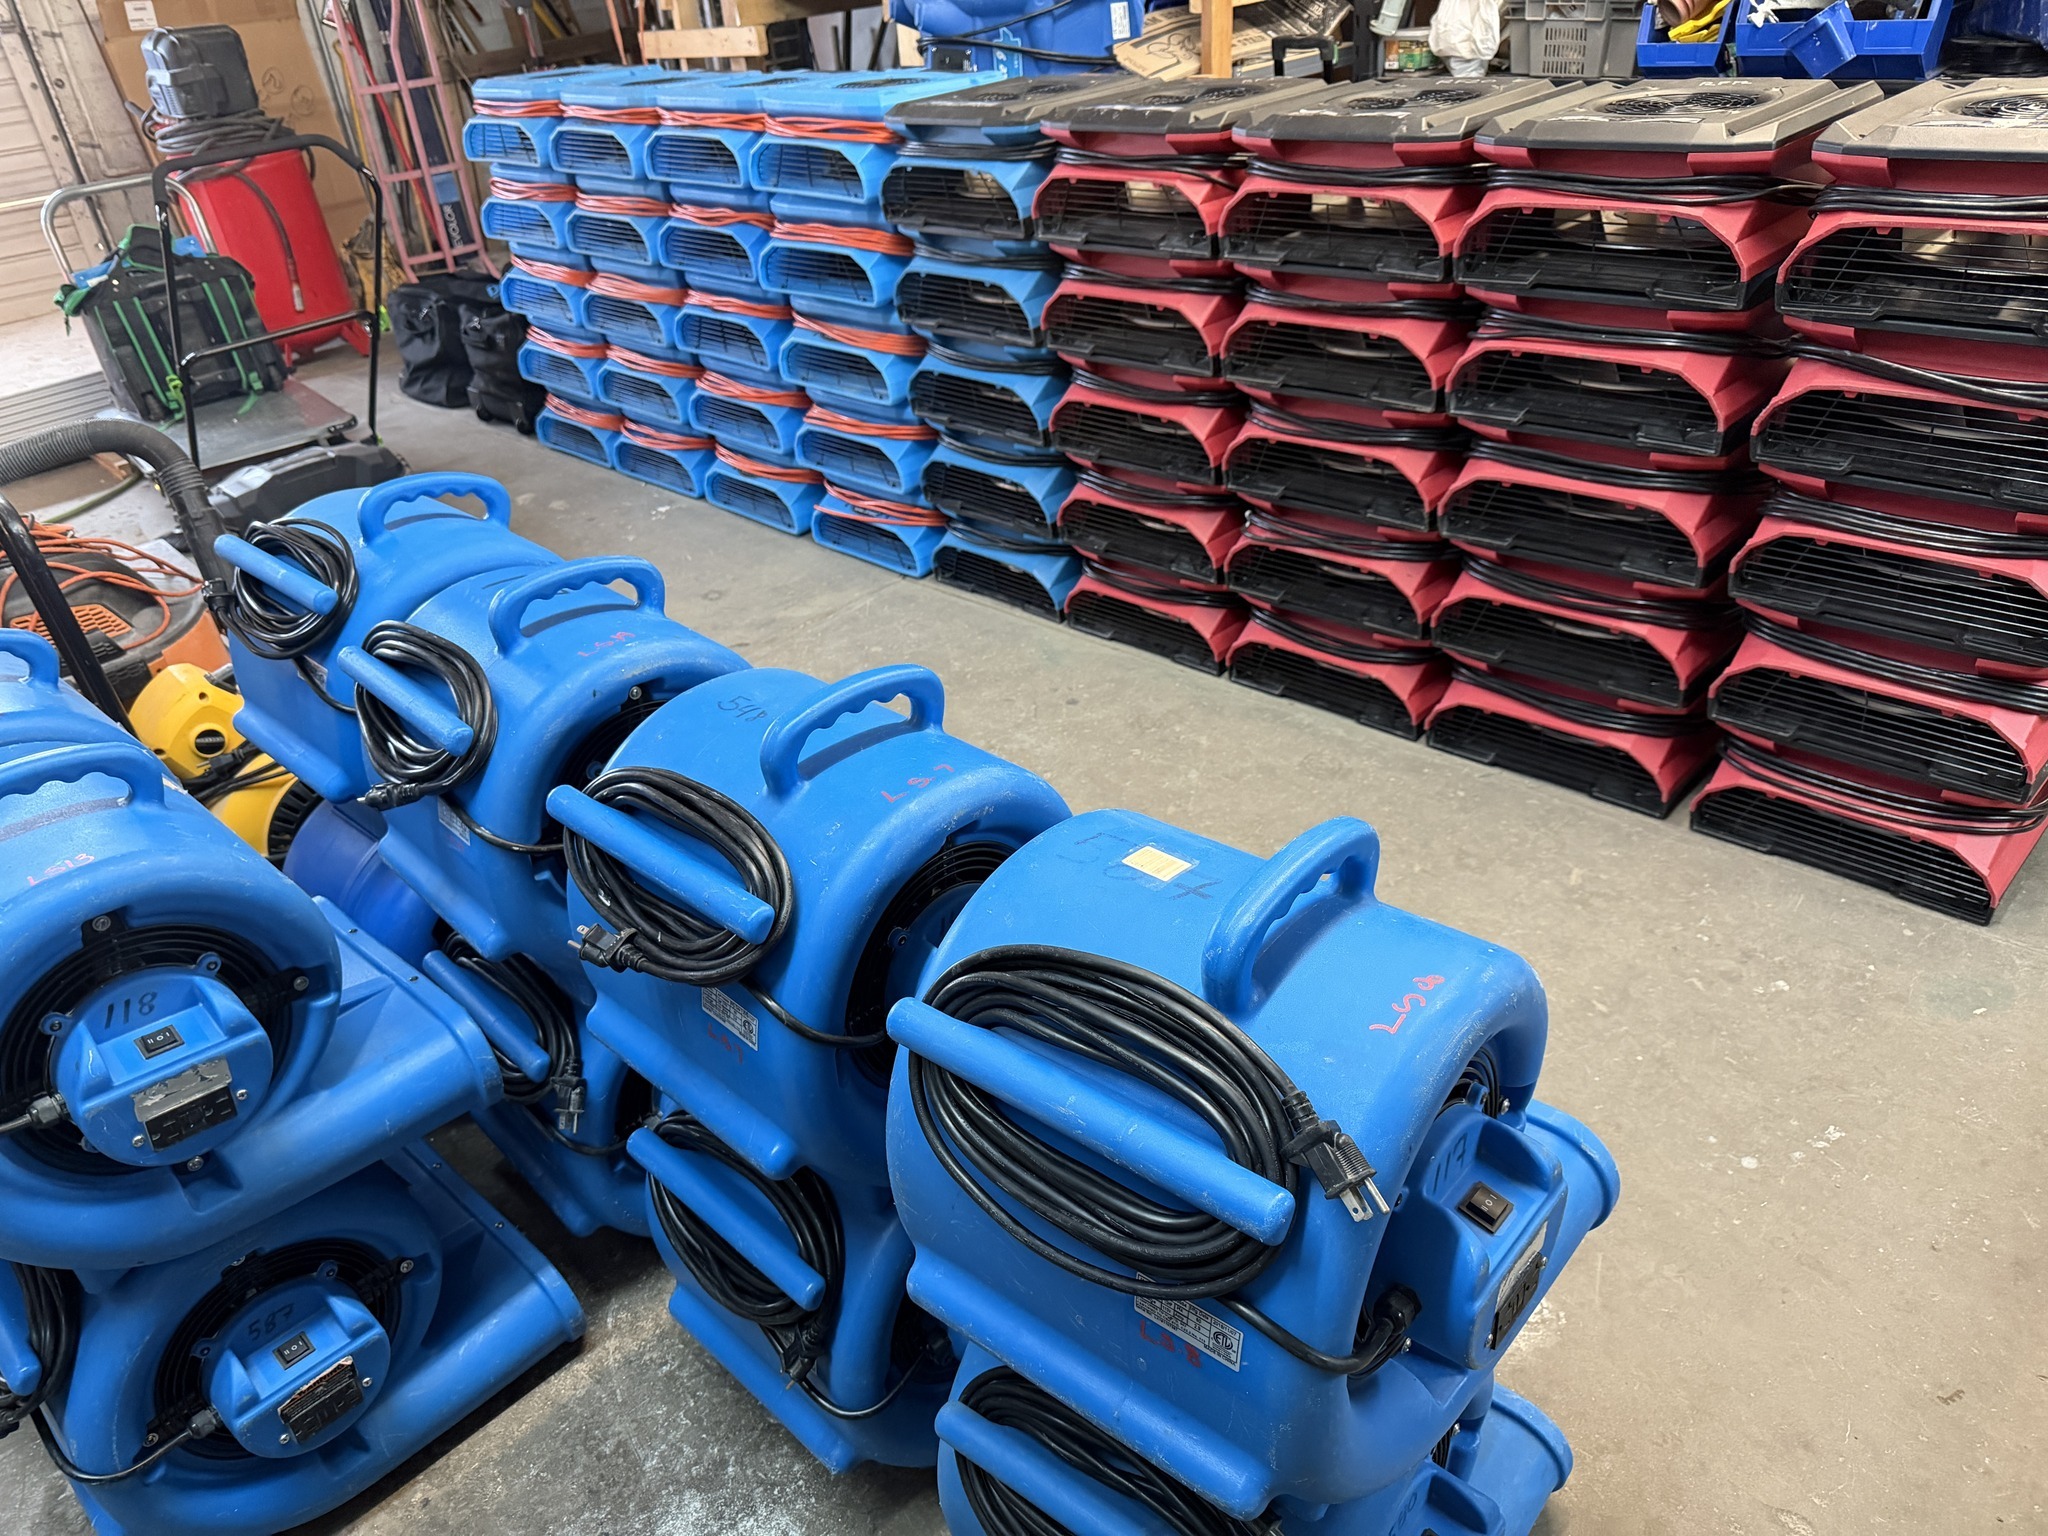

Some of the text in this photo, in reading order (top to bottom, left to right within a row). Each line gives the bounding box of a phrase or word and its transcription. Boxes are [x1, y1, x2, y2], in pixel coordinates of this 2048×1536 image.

[442, 204, 463, 249] EVOLOR
[104, 991, 158, 1030] 118
[1432, 1132, 1468, 1195] 117
[247, 1302, 295, 1341] 587
